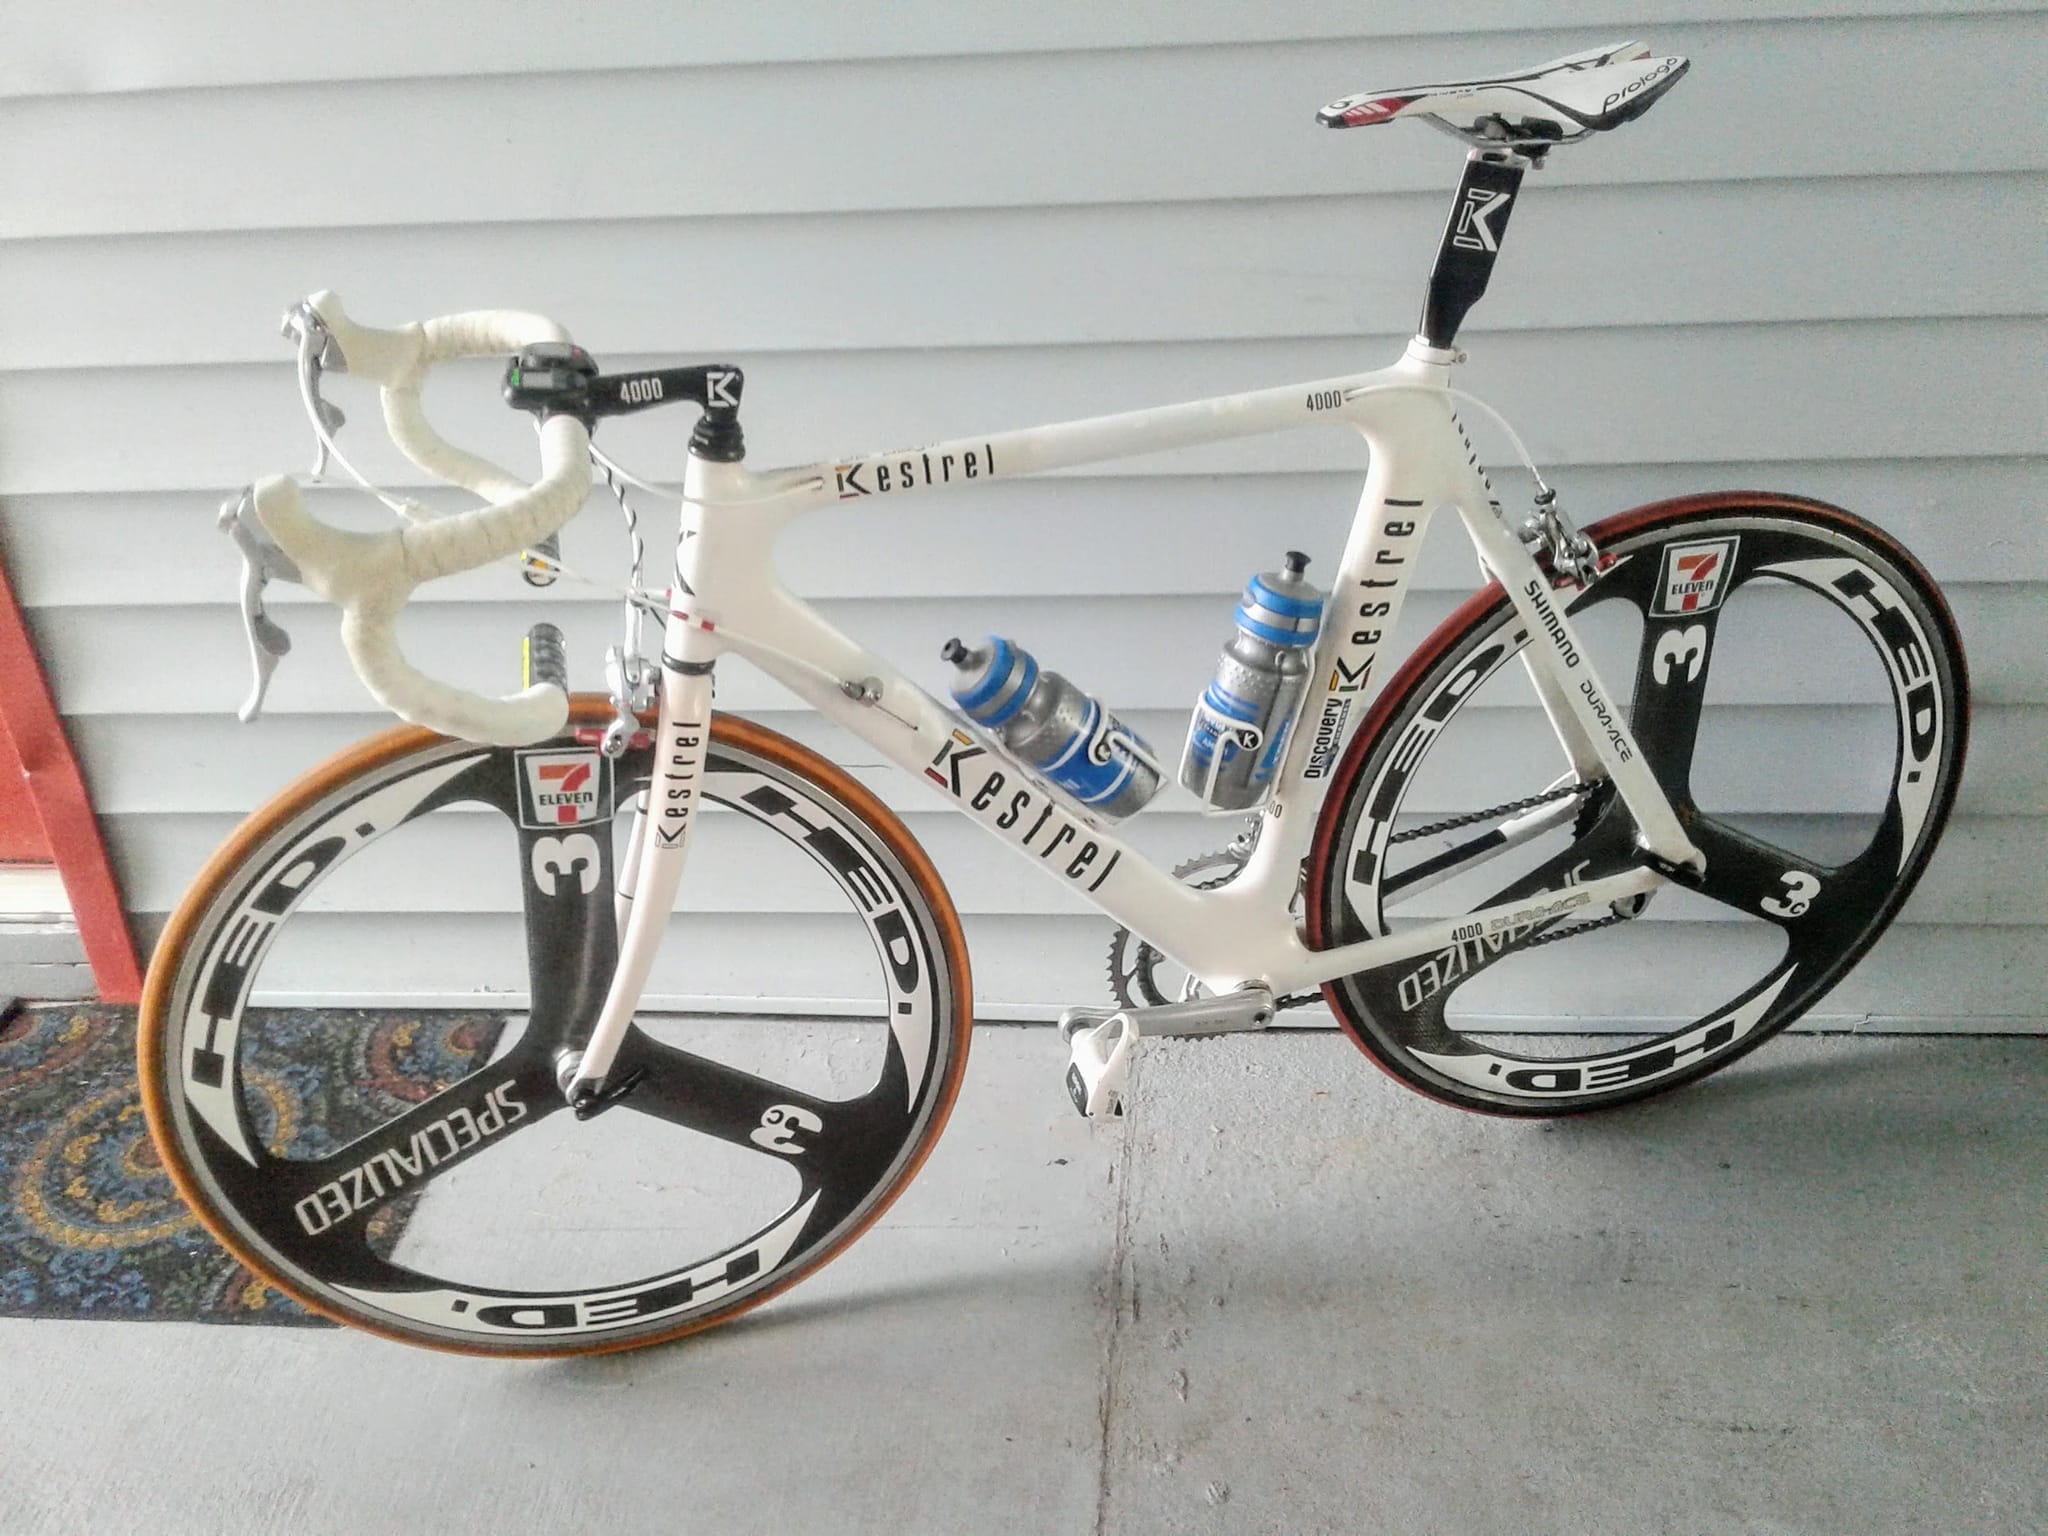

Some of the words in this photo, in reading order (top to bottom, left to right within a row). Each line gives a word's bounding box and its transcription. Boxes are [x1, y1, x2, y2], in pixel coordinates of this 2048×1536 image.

[1602, 57, 1678, 114] prologo
[620, 377, 663, 404] 4000
[1306, 390, 1341, 412] 4000
[834, 443, 995, 499] Kestrel
[1328, 498, 1424, 692] Kestrel
[1677, 552, 1719, 612] 7
[1524, 580, 1580, 669] SHIMANO
[1304, 698, 1343, 779] Discovery
[538, 763, 592, 825] 7
[655, 722, 702, 849] Kestrel
[926, 729, 1122, 893] Kestrel
[1451, 922, 1483, 942] 4000
[294, 1079, 528, 1236] SPECIALIZED
